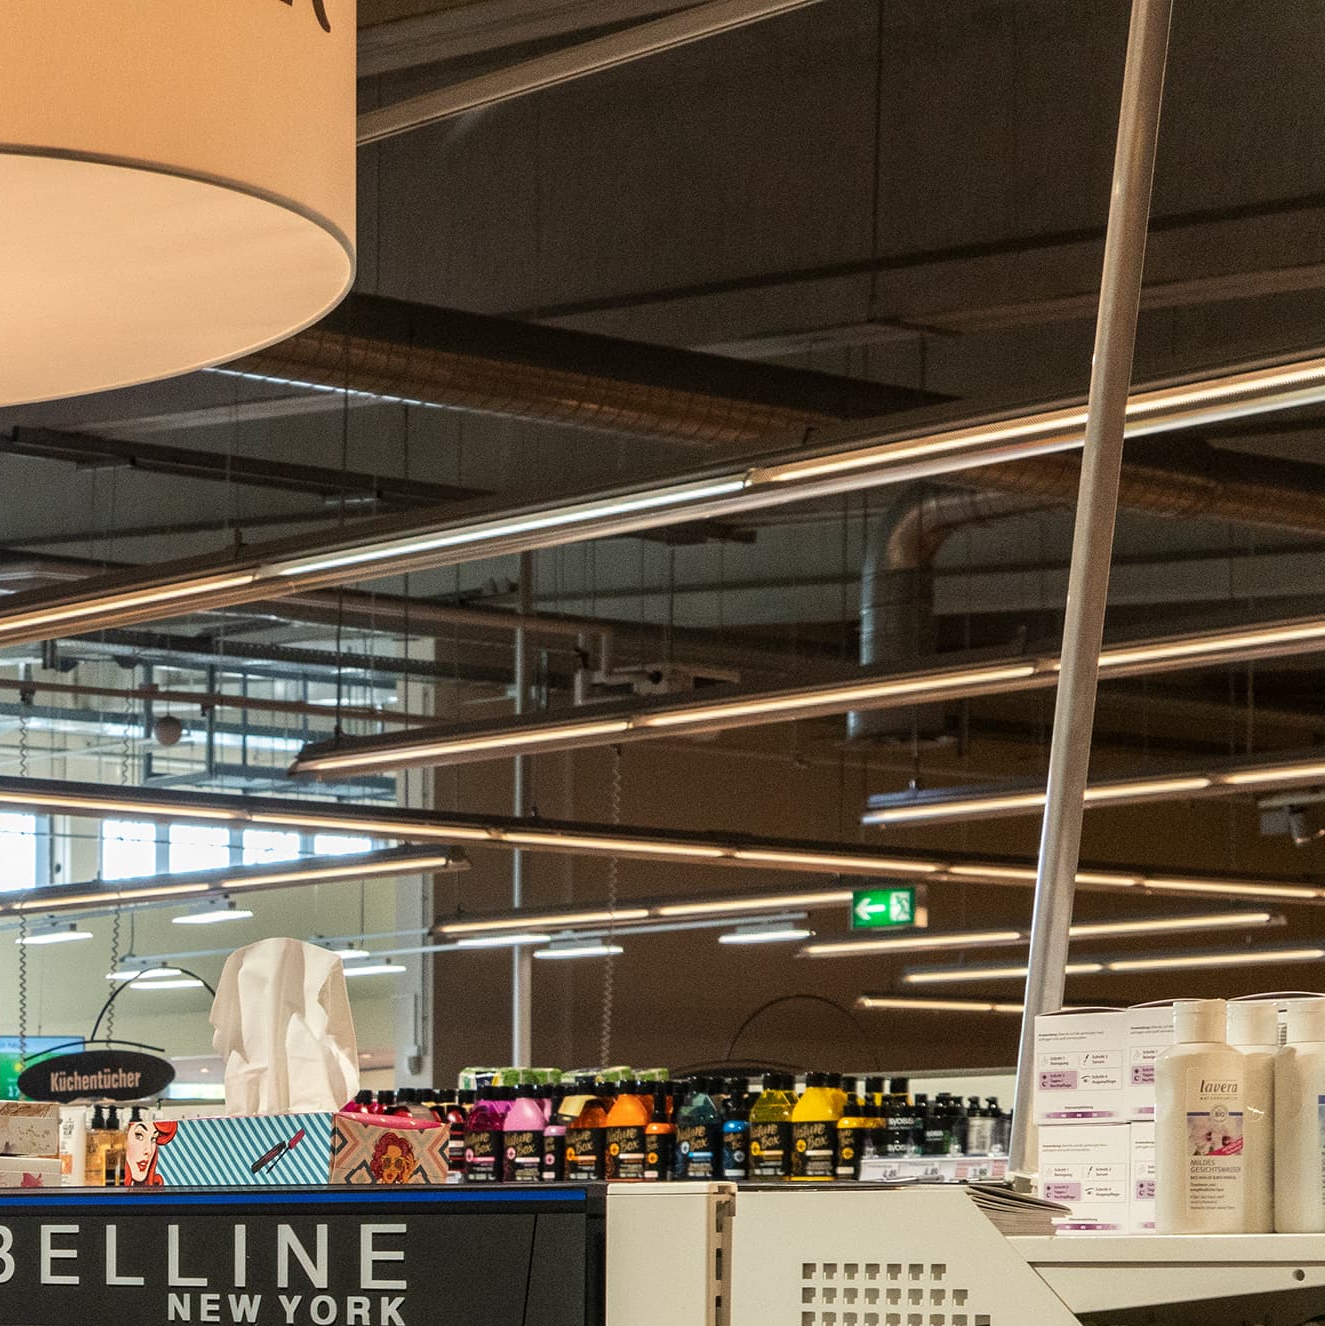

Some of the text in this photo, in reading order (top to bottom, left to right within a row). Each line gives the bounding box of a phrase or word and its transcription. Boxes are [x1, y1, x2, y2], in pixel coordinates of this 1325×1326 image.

[50, 1070, 141, 1092] Küchentücher
[1200, 1079, 1238, 1094] lavera
[167, 1291, 263, 1324] NEW
